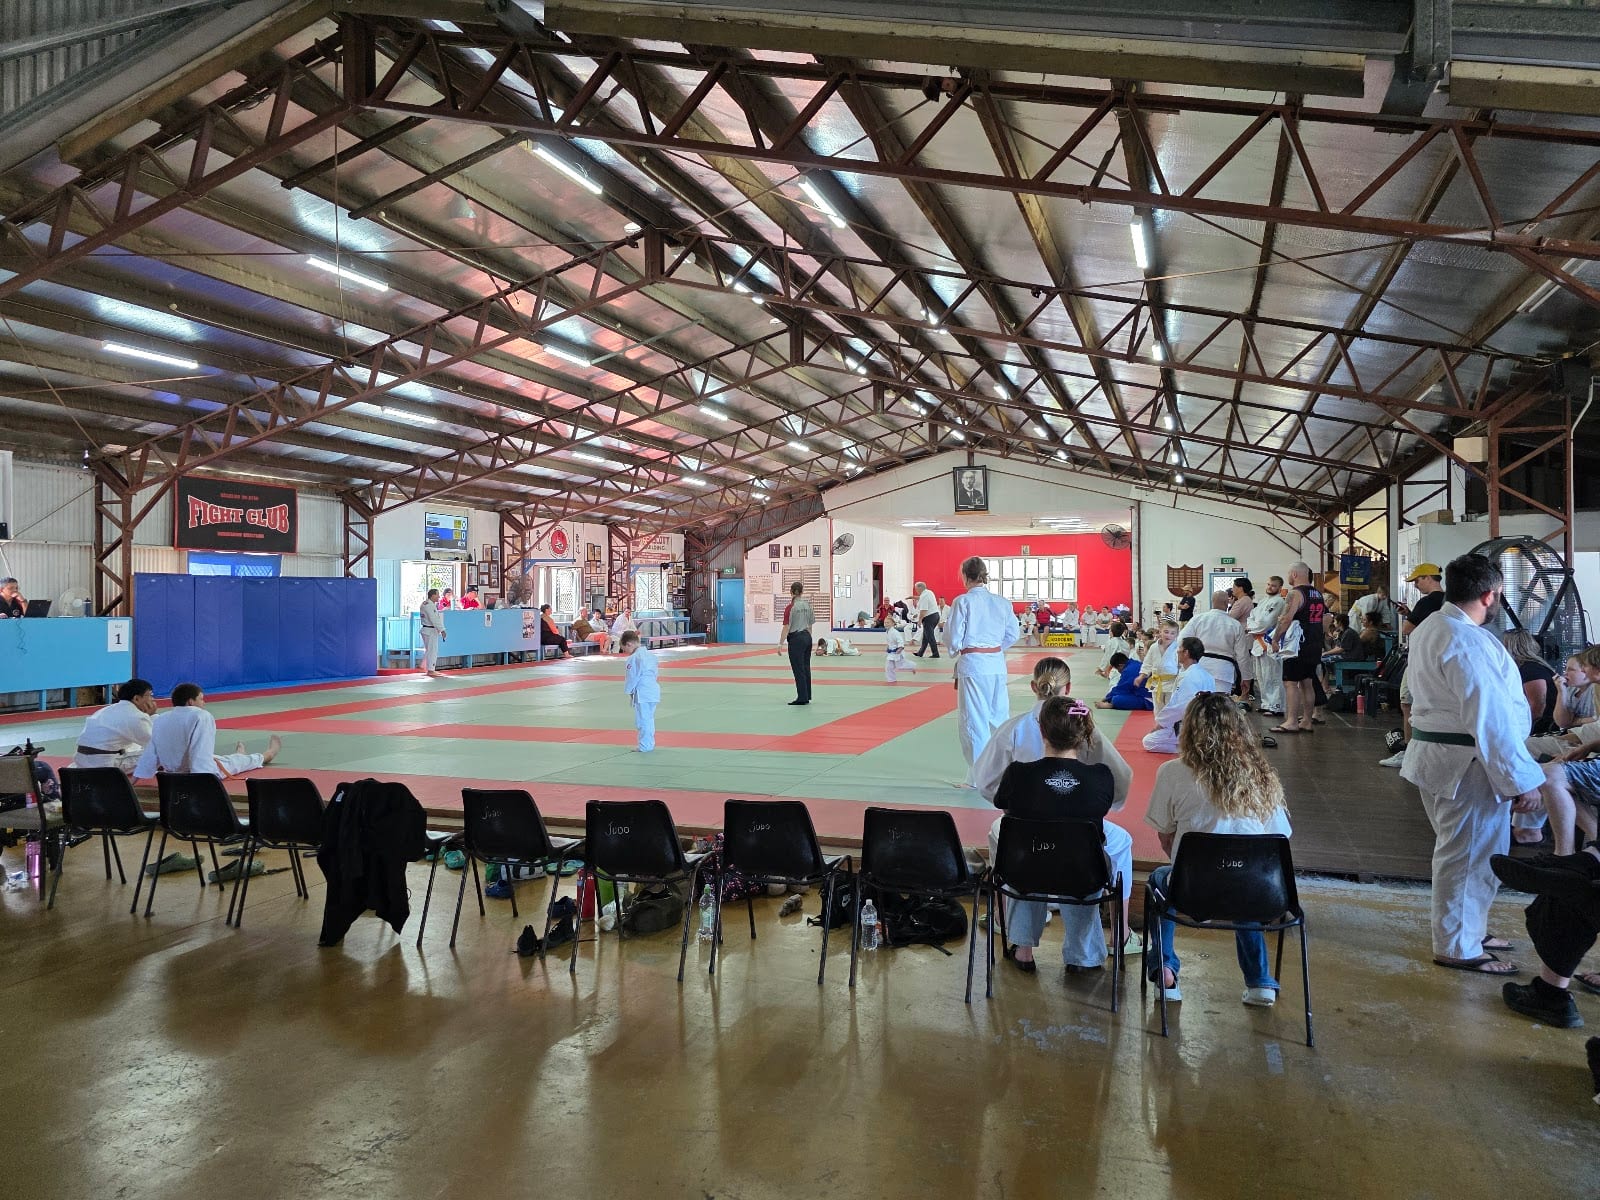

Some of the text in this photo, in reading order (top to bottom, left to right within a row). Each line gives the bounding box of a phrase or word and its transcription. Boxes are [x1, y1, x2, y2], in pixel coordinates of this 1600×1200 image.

[187, 494, 290, 534] FIGHT CLUB
[115, 633, 122, 645] 1
